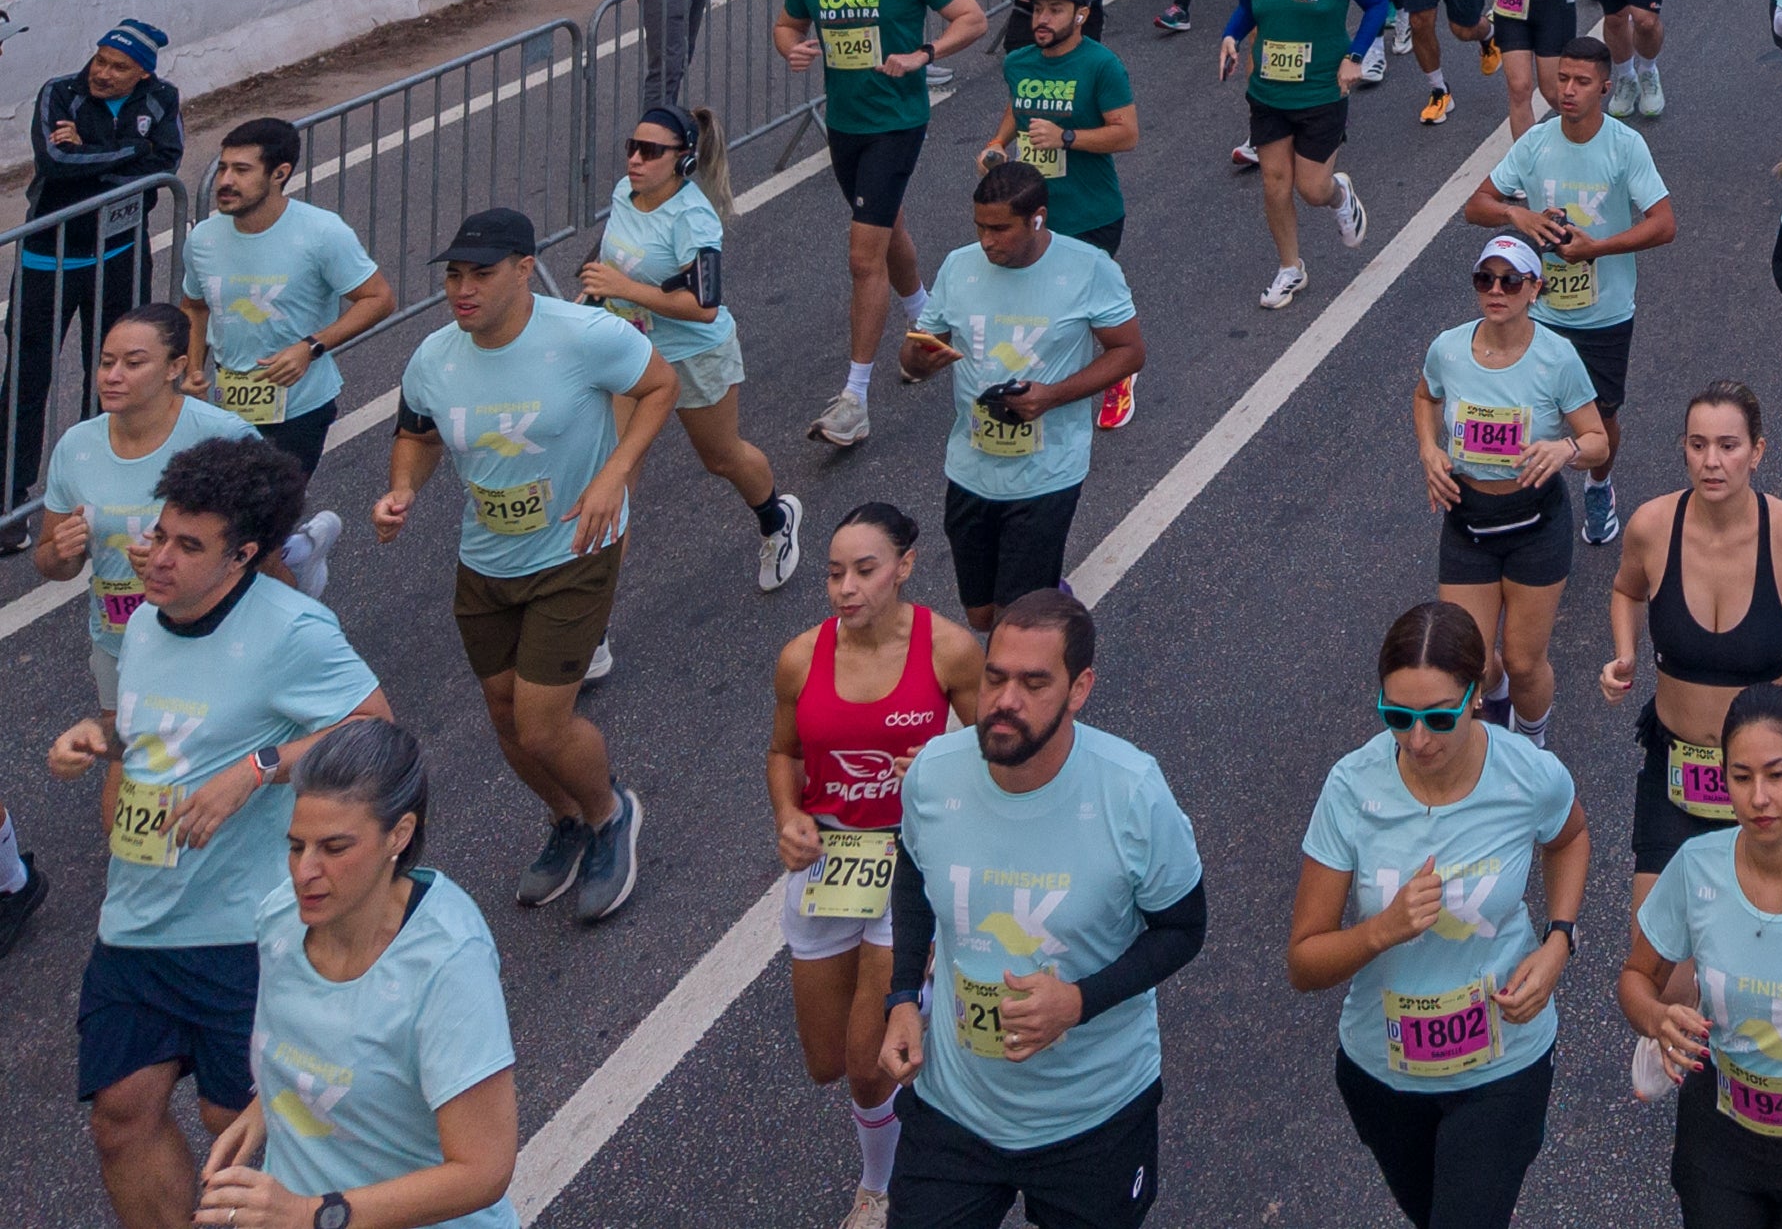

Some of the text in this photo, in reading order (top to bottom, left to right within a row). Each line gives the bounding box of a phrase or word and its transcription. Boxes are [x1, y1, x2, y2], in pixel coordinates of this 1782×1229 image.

[819, 8, 880, 20] NO IBIRA
[835, 40, 873, 56] 1249
[1270, 52, 1304, 68] 2016
[1017, 78, 1077, 101] CORRE
[1015, 97, 1073, 111] NO IBIRA
[1022, 145, 1058, 164] 2130
[1548, 273, 1590, 294] 2122
[227, 385, 275, 405] 2023
[475, 401, 542, 415] FINISHER
[983, 420, 1033, 439] 2175
[1470, 422, 1518, 446] 1841
[484, 495, 543, 520] 2192
[885, 710, 934, 727] dobro
[1682, 746, 1716, 760] SP10K
[1689, 770, 1728, 793] 135
[115, 798, 167, 835] 2124
[828, 834, 862, 849] SP10K
[823, 856, 894, 889] 2759
[984, 868, 1071, 891] FINISHER
[1399, 994, 1442, 1011] SP10K
[970, 1001, 1002, 1032] 21
[1408, 1007, 1486, 1050] 1802
[1729, 1063, 1768, 1087] SP10K
